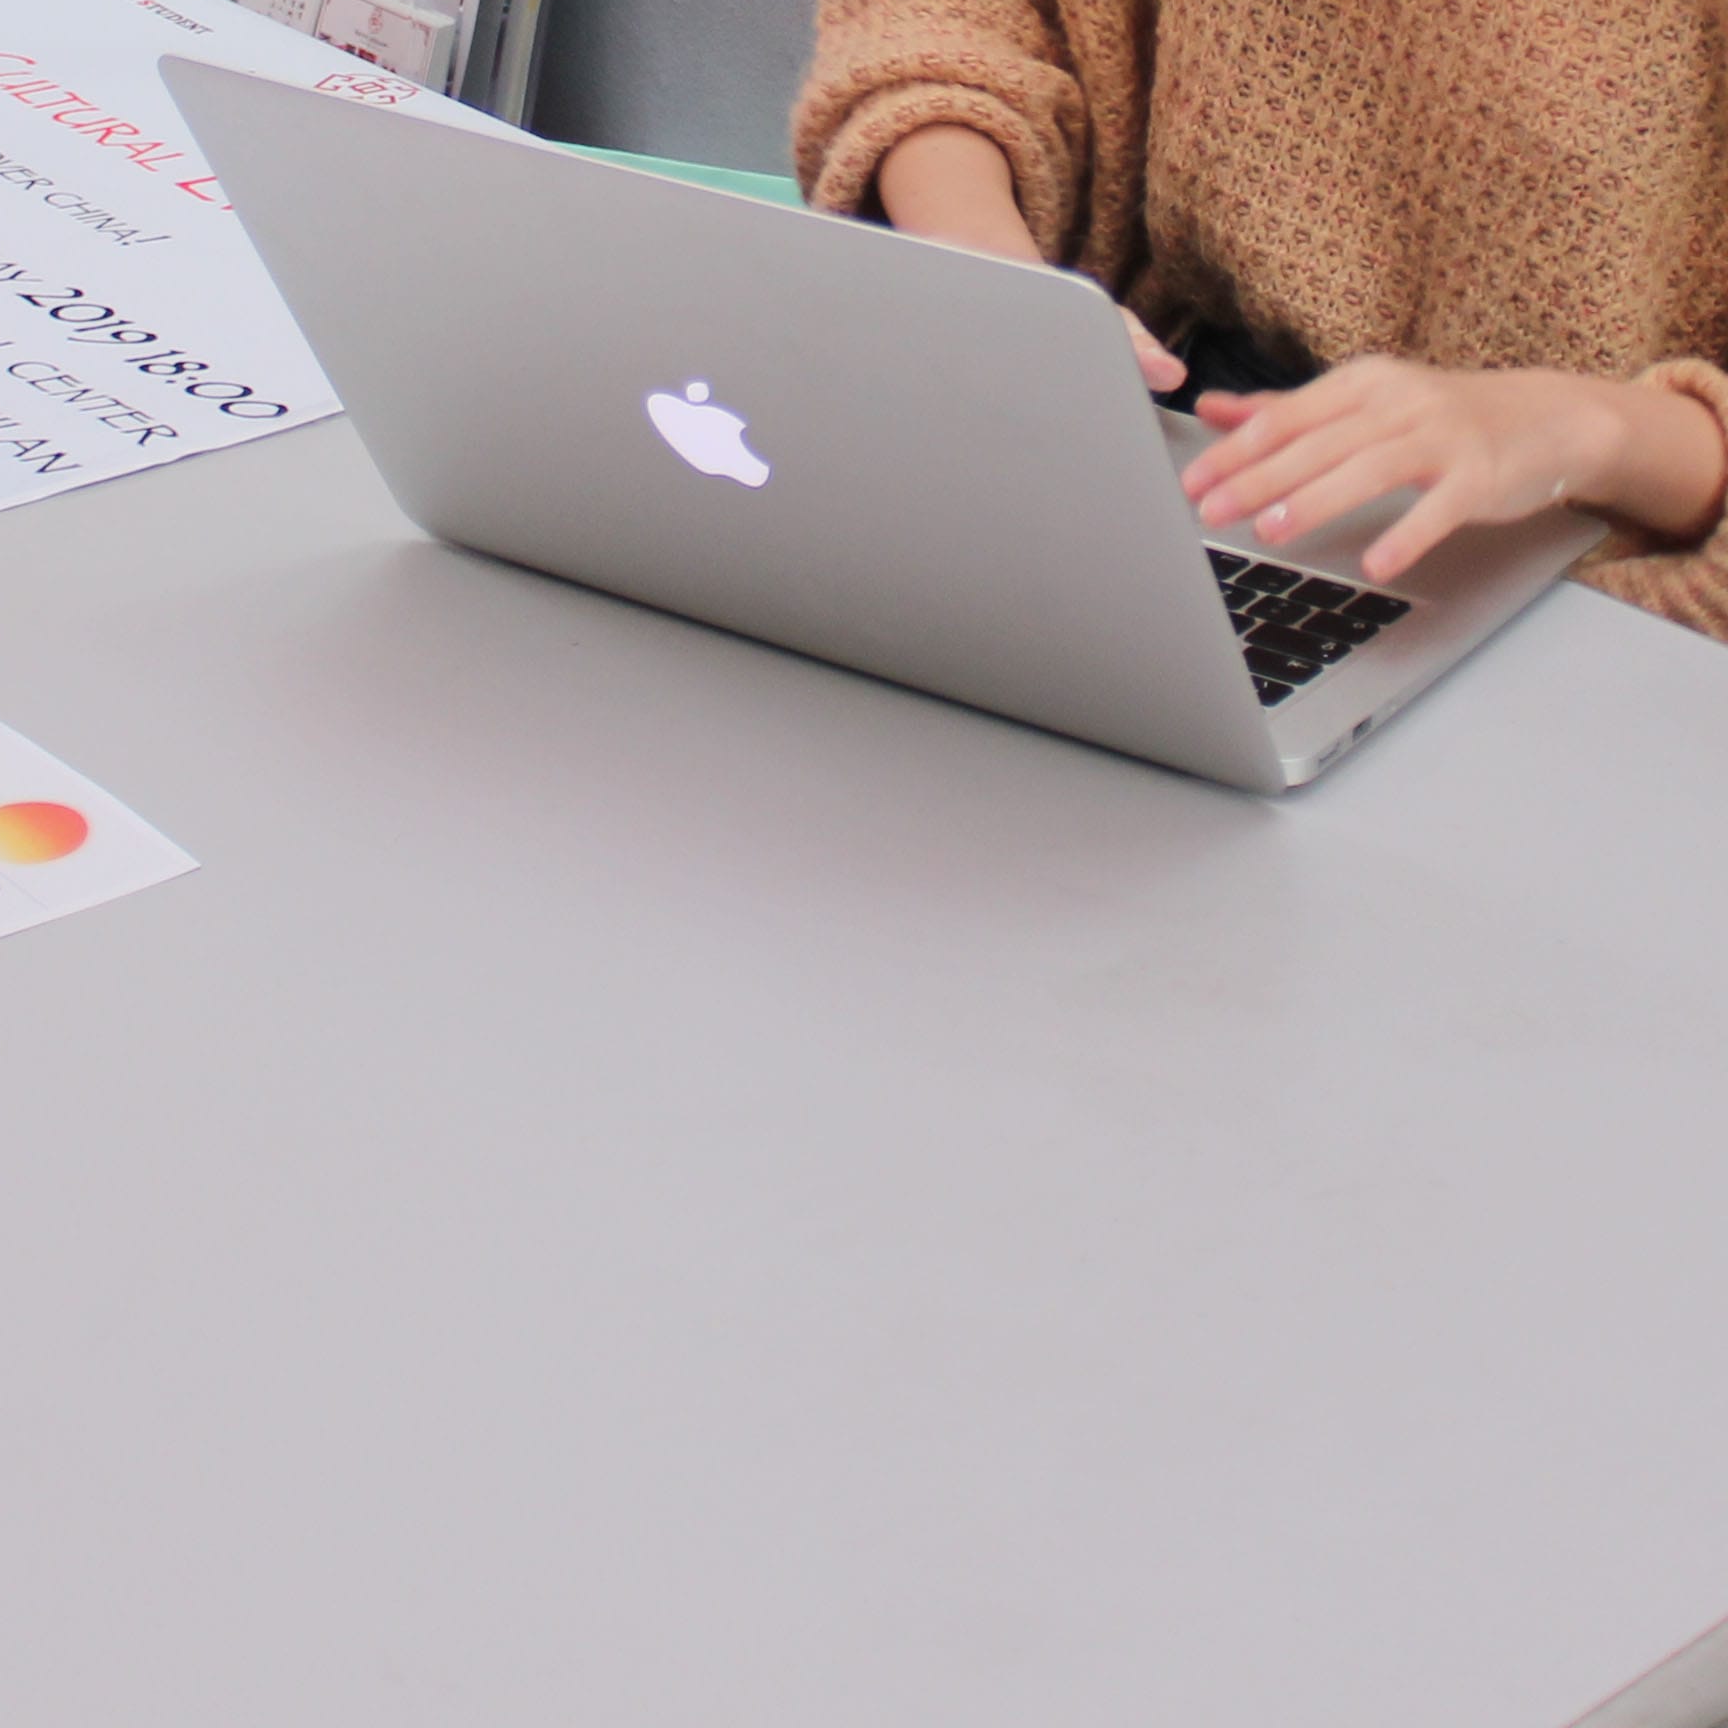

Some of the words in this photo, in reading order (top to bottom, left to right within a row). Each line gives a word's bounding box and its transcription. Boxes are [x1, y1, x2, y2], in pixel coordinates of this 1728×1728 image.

[44, 192, 172, 246] CHINA!
[16, 287, 158, 344] 2019
[124, 349, 288, 418] 18:00
[7, 361, 179, 446] CENTER
